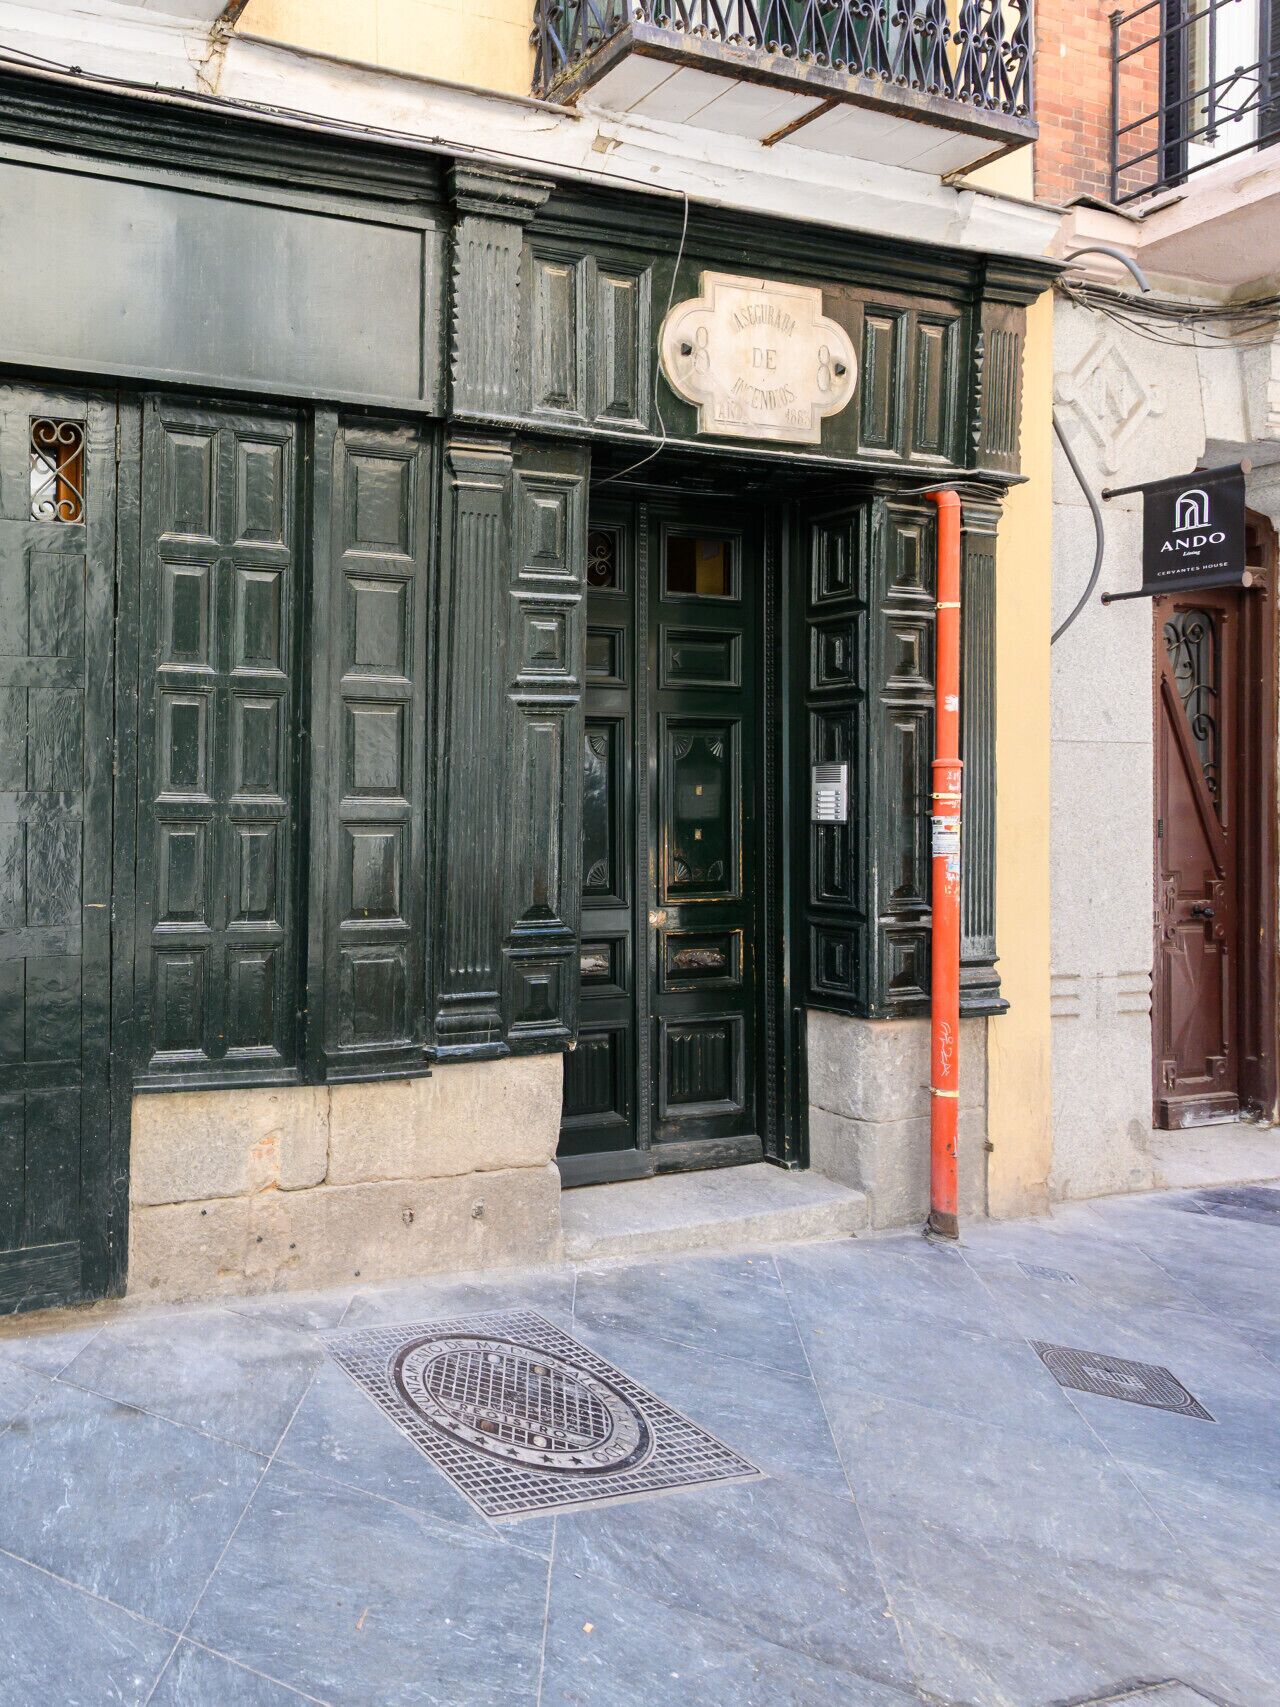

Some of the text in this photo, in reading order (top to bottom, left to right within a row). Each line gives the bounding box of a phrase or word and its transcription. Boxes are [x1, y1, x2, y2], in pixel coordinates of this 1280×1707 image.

[752, 347, 777, 370] DE
[1160, 531, 1226, 553] ANDO
[1156, 561, 1229, 577] CERVANTES HOUSE
[444, 1340, 467, 1349] DE
[460, 1403, 566, 1439] REGISTRO
